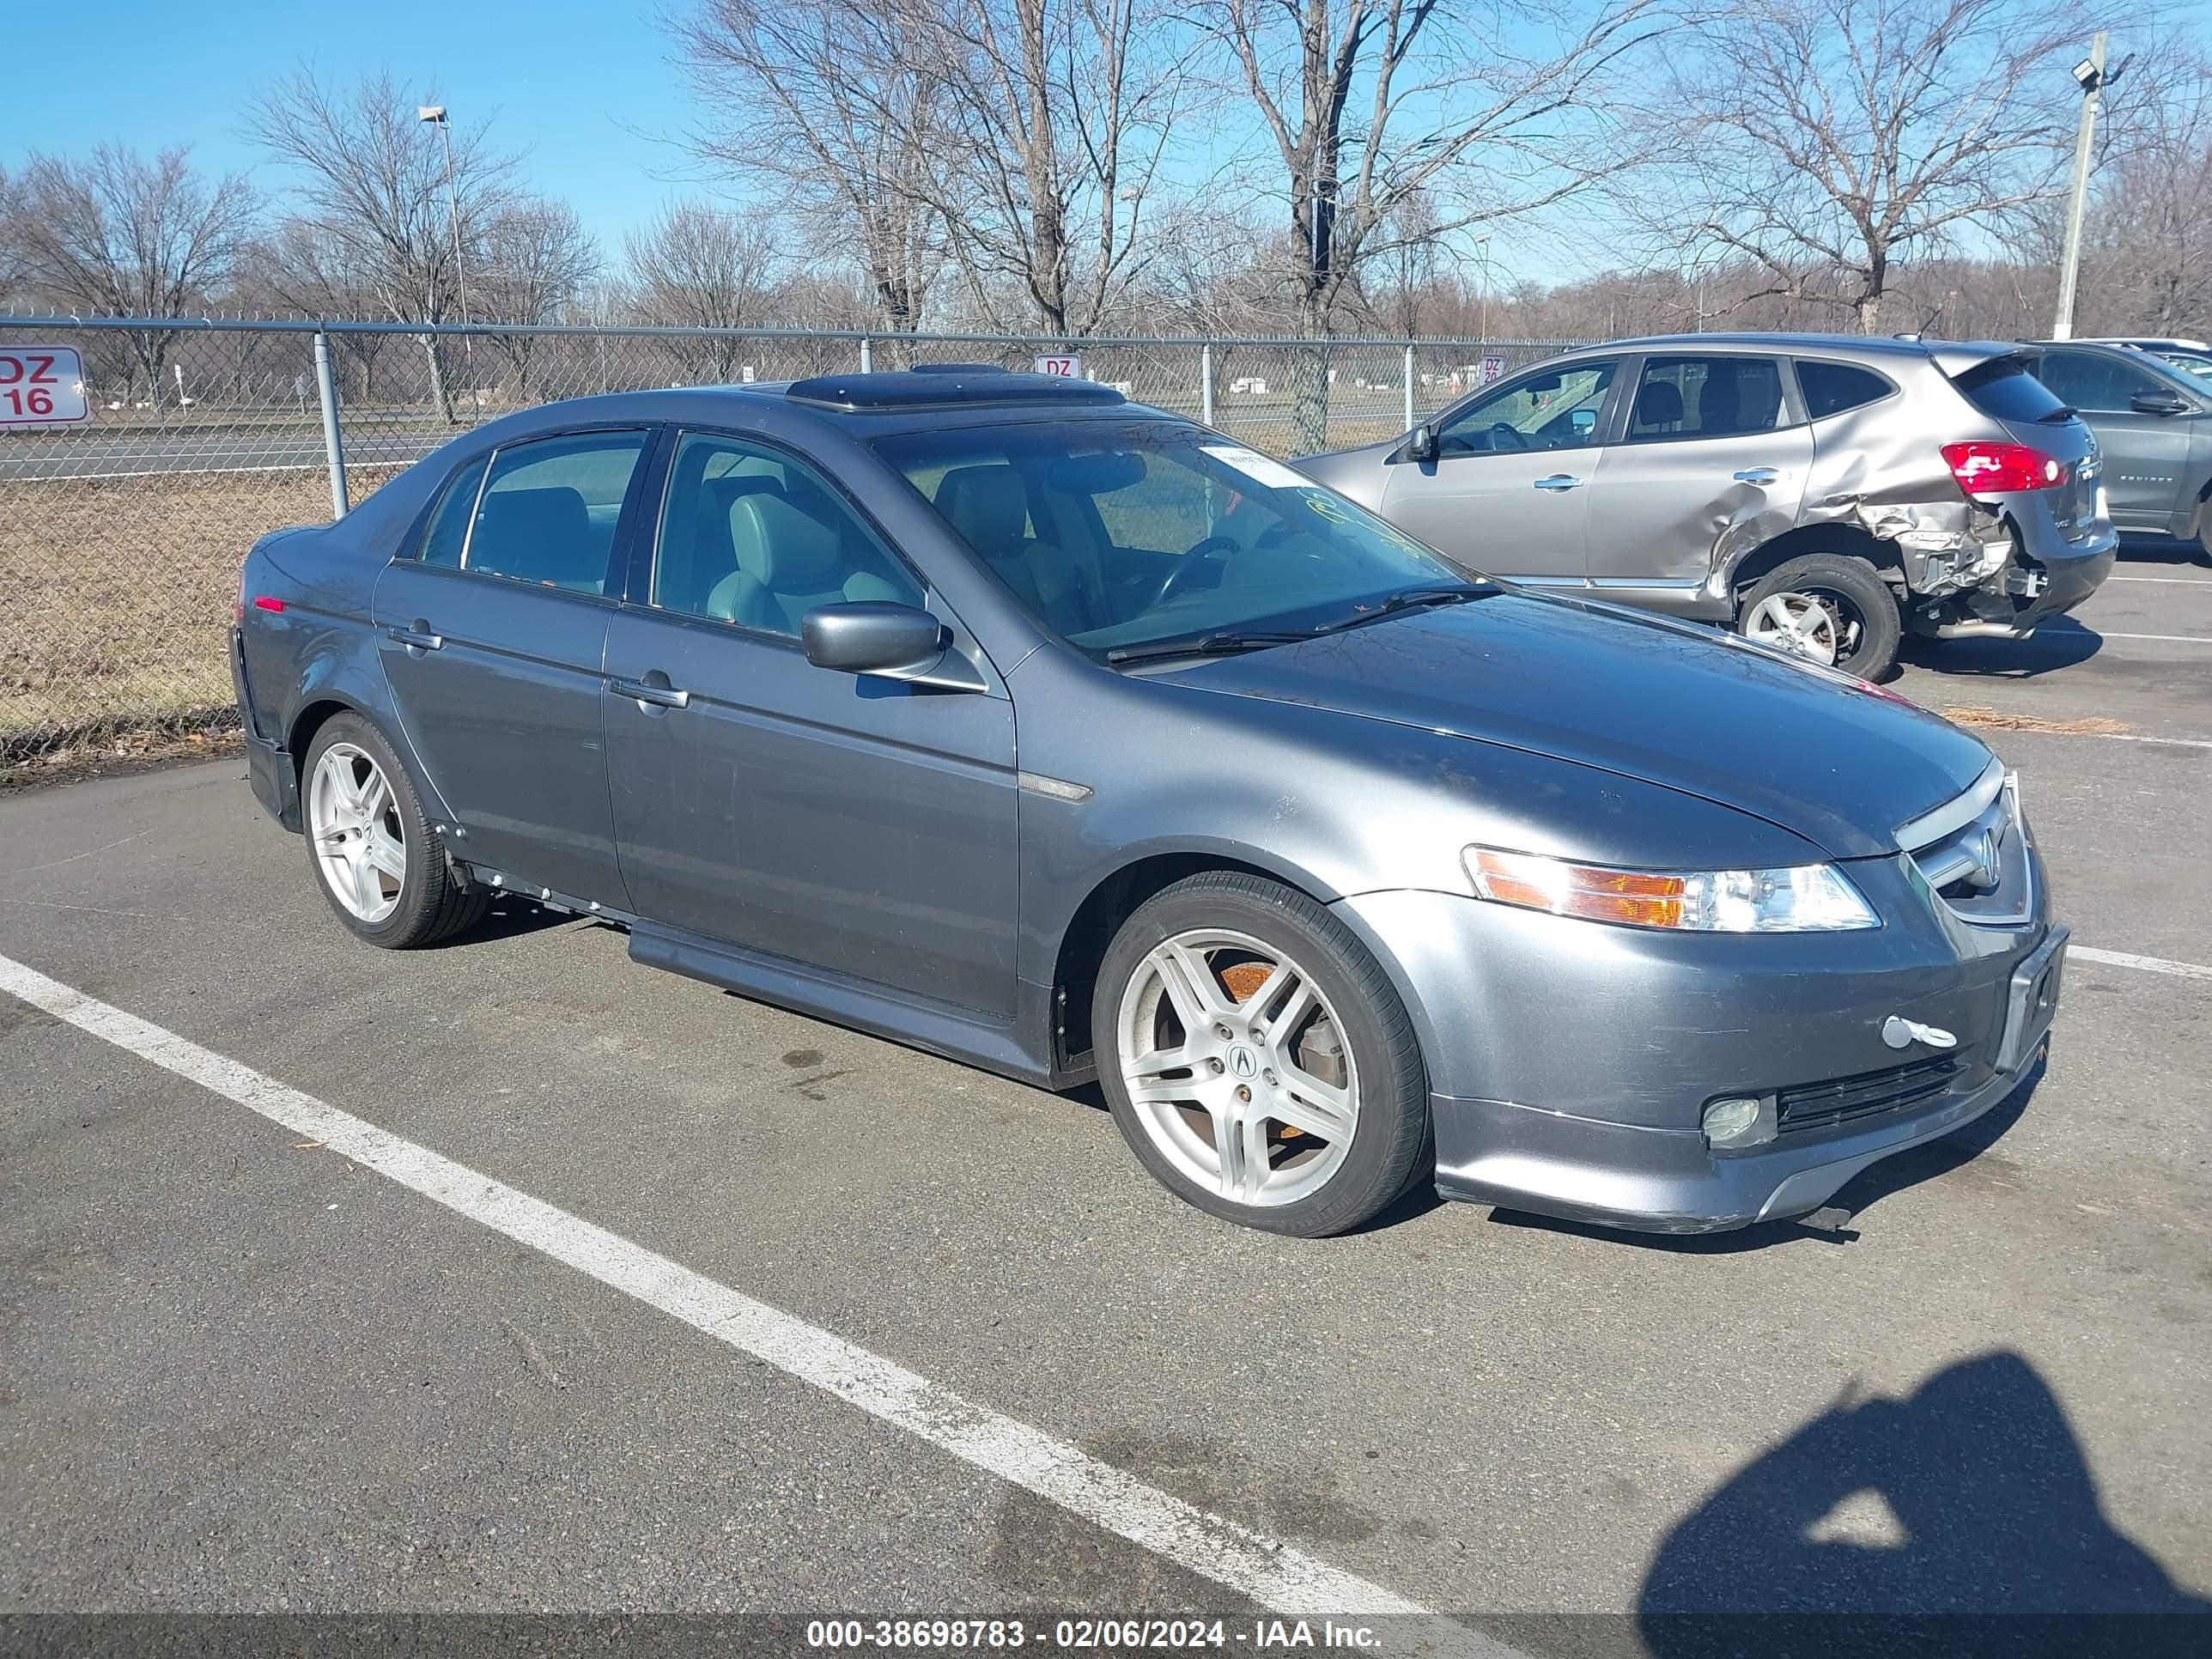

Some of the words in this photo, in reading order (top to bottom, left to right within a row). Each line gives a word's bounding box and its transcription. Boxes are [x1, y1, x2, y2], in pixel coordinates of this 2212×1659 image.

[0, 356, 58, 384] DZ
[1047, 360, 1071, 377] DZ
[1486, 358, 1500, 371] DZ
[3, 387, 53, 416] 16
